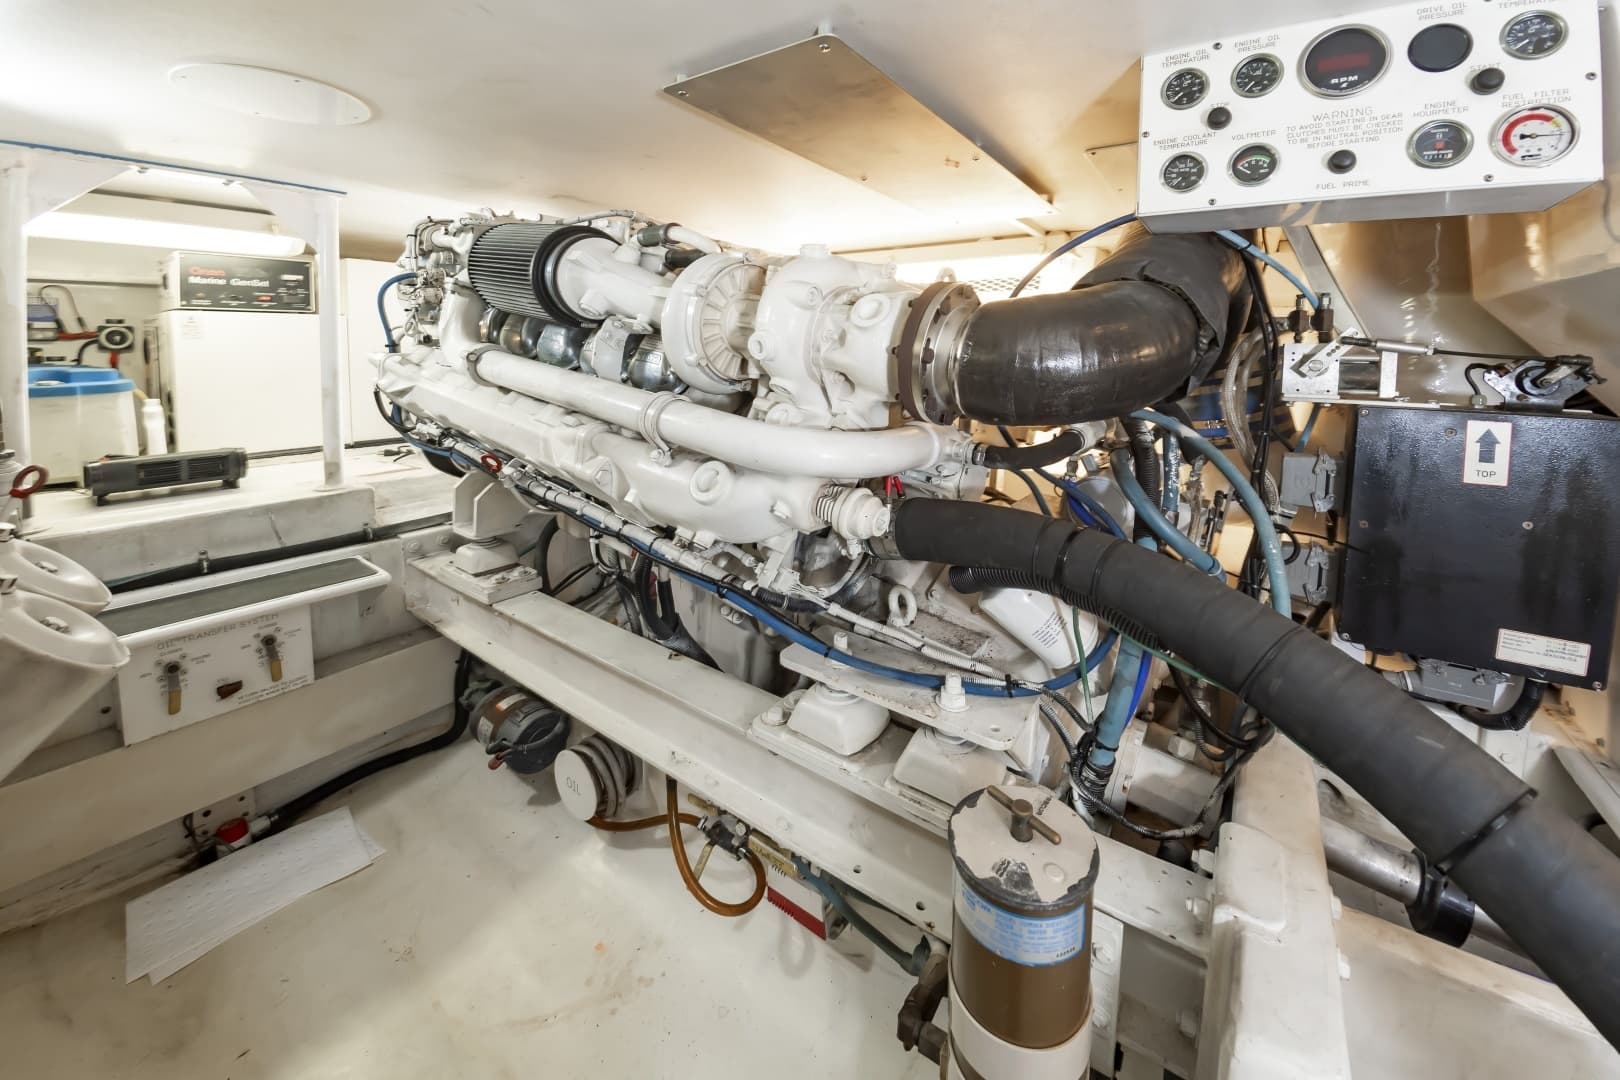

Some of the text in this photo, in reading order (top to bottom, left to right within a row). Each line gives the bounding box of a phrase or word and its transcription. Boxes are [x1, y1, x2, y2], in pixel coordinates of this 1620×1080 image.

[1417, 2, 1467, 15] DRIVE OIL
[1418, 9, 1465, 20] PRESSURE
[1234, 34, 1281, 48] ENGINE OIL
[1238, 42, 1276, 53] PRESSURE
[1162, 54, 1210, 69] TEMPERATURE
[1165, 48, 1208, 62] ENGINE OIL
[1331, 75, 1358, 84] RPM
[1502, 88, 1569, 101] FUEL FILTER
[1413, 105, 1469, 117] HOURMETER
[1424, 100, 1457, 109] ENGINE
[1312, 106, 1374, 122] WARNING
[1299, 122, 1323, 130] AVOID
[1325, 117, 1366, 127] STARTING
[1381, 112, 1403, 120] GEAR
[1232, 130, 1276, 140] VOLTMETER
[1287, 128, 1326, 139] CLUTCHES
[1366, 120, 1403, 129] CHECKED
[1323, 131, 1359, 141] NEUTRAL
[1362, 126, 1404, 136] POSITION
[1153, 131, 1217, 146] ENGINE COOLANT
[1159, 139, 1208, 151] TEMPERATURE
[1307, 135, 1380, 149] BEFORE STARTING
[1475, 469, 1497, 479] TOP
[181, 624, 236, 642] TRANSFER
